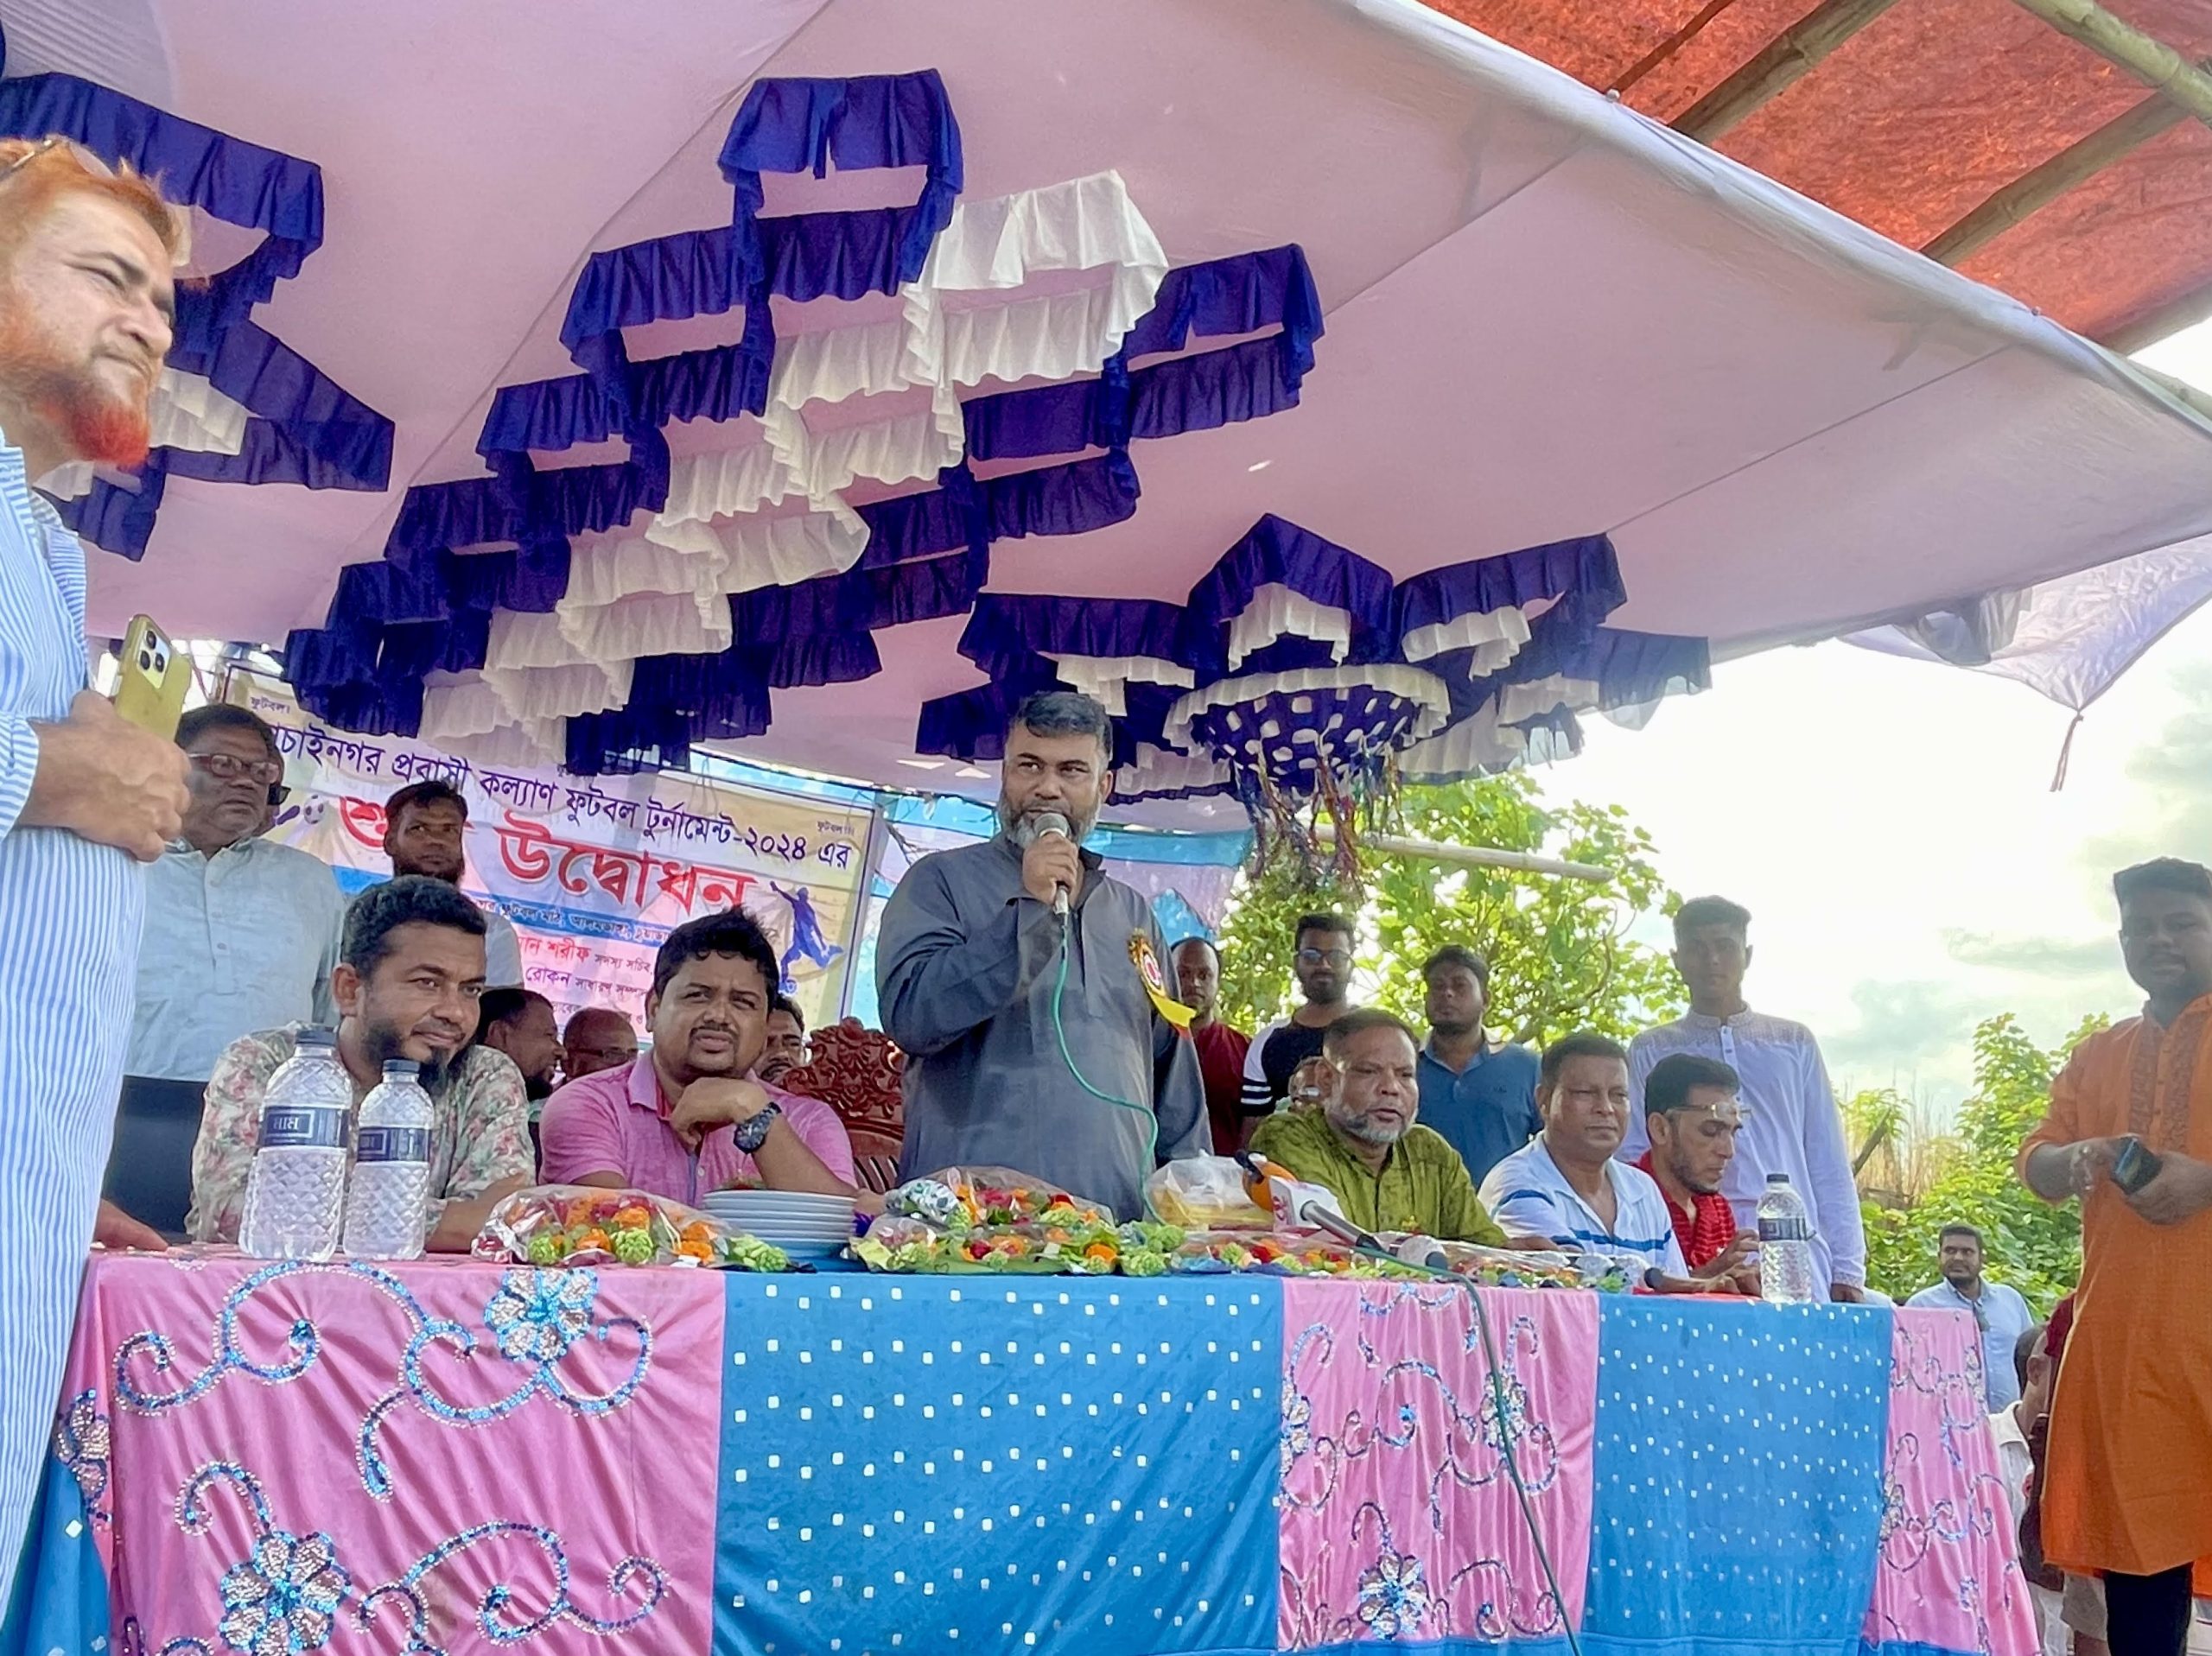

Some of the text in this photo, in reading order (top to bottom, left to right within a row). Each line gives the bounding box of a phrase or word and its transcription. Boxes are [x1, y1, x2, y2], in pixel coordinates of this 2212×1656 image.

[480, 770, 559, 811] কল্যাণ
[566, 784, 640, 828] ফুটবল
[818, 842, 852, 870] এর
[493, 809, 759, 917] উদ্বোধন
[525, 966, 573, 987] রোকন
[547, 936, 593, 963] শরীফ
